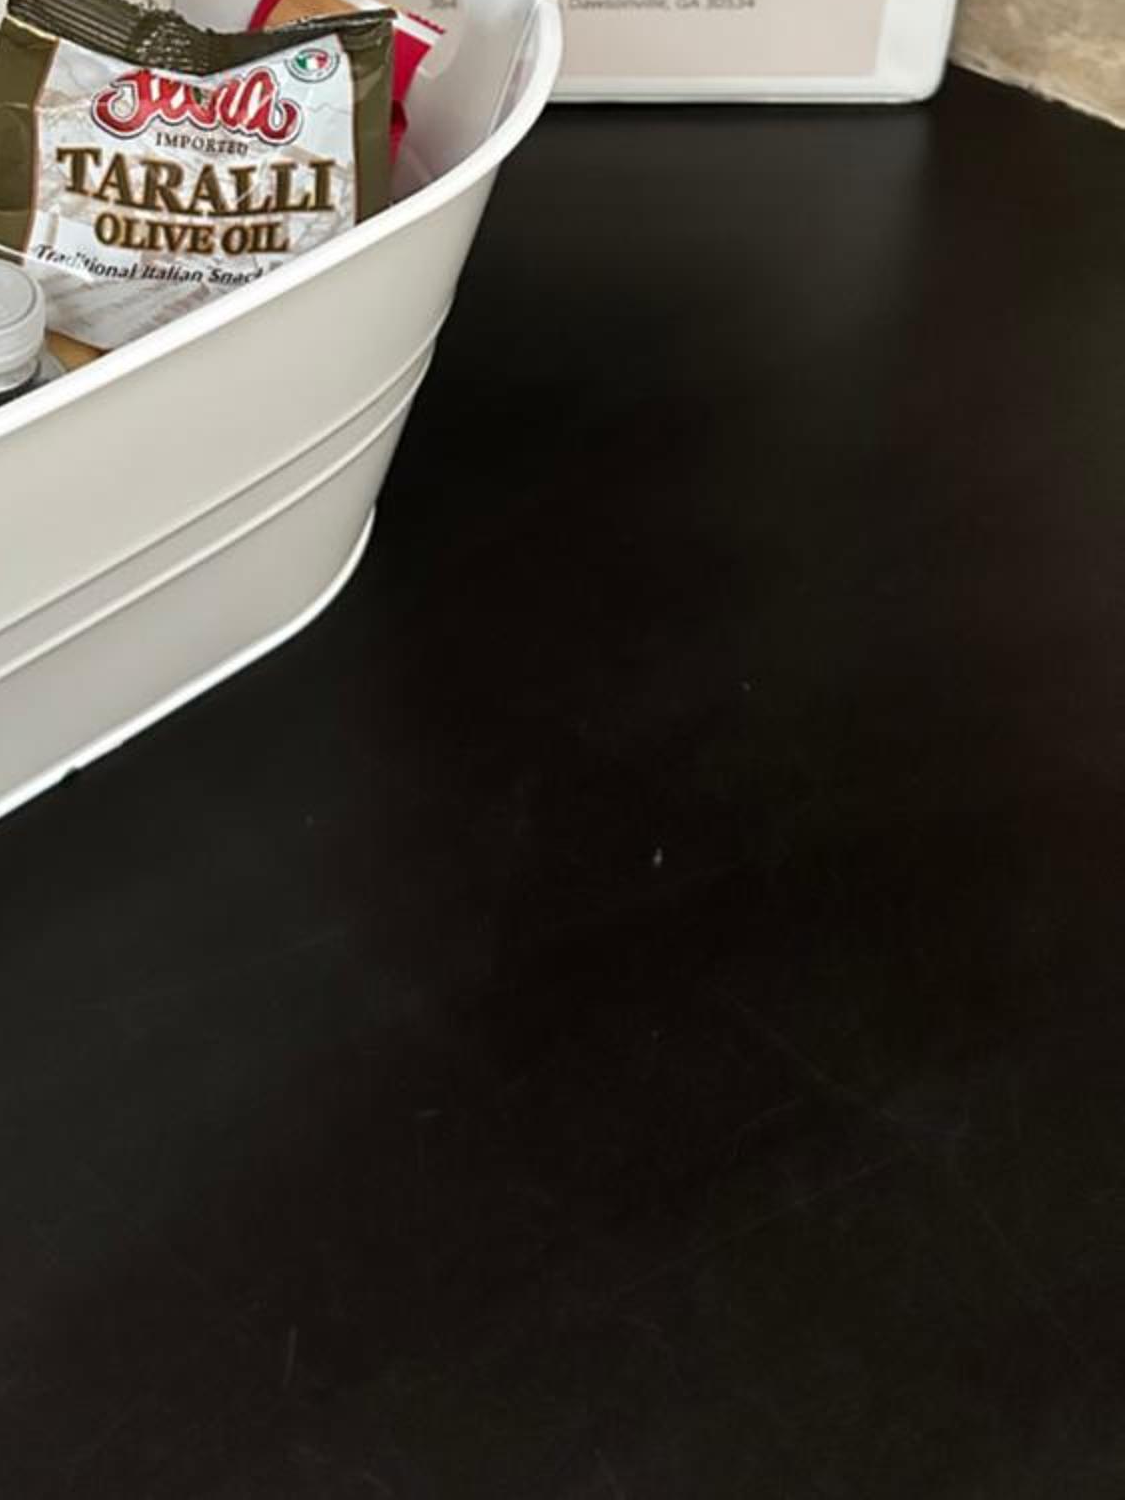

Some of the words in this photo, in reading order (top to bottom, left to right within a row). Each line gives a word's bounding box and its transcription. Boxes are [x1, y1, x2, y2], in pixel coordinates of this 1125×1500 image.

[155, 131, 249, 157] IMPORTED
[55, 146, 336, 217] TARALLI
[94, 211, 215, 254] OLIVE
[221, 220, 290, 256] OIL
[141, 264, 203, 282] Italian
